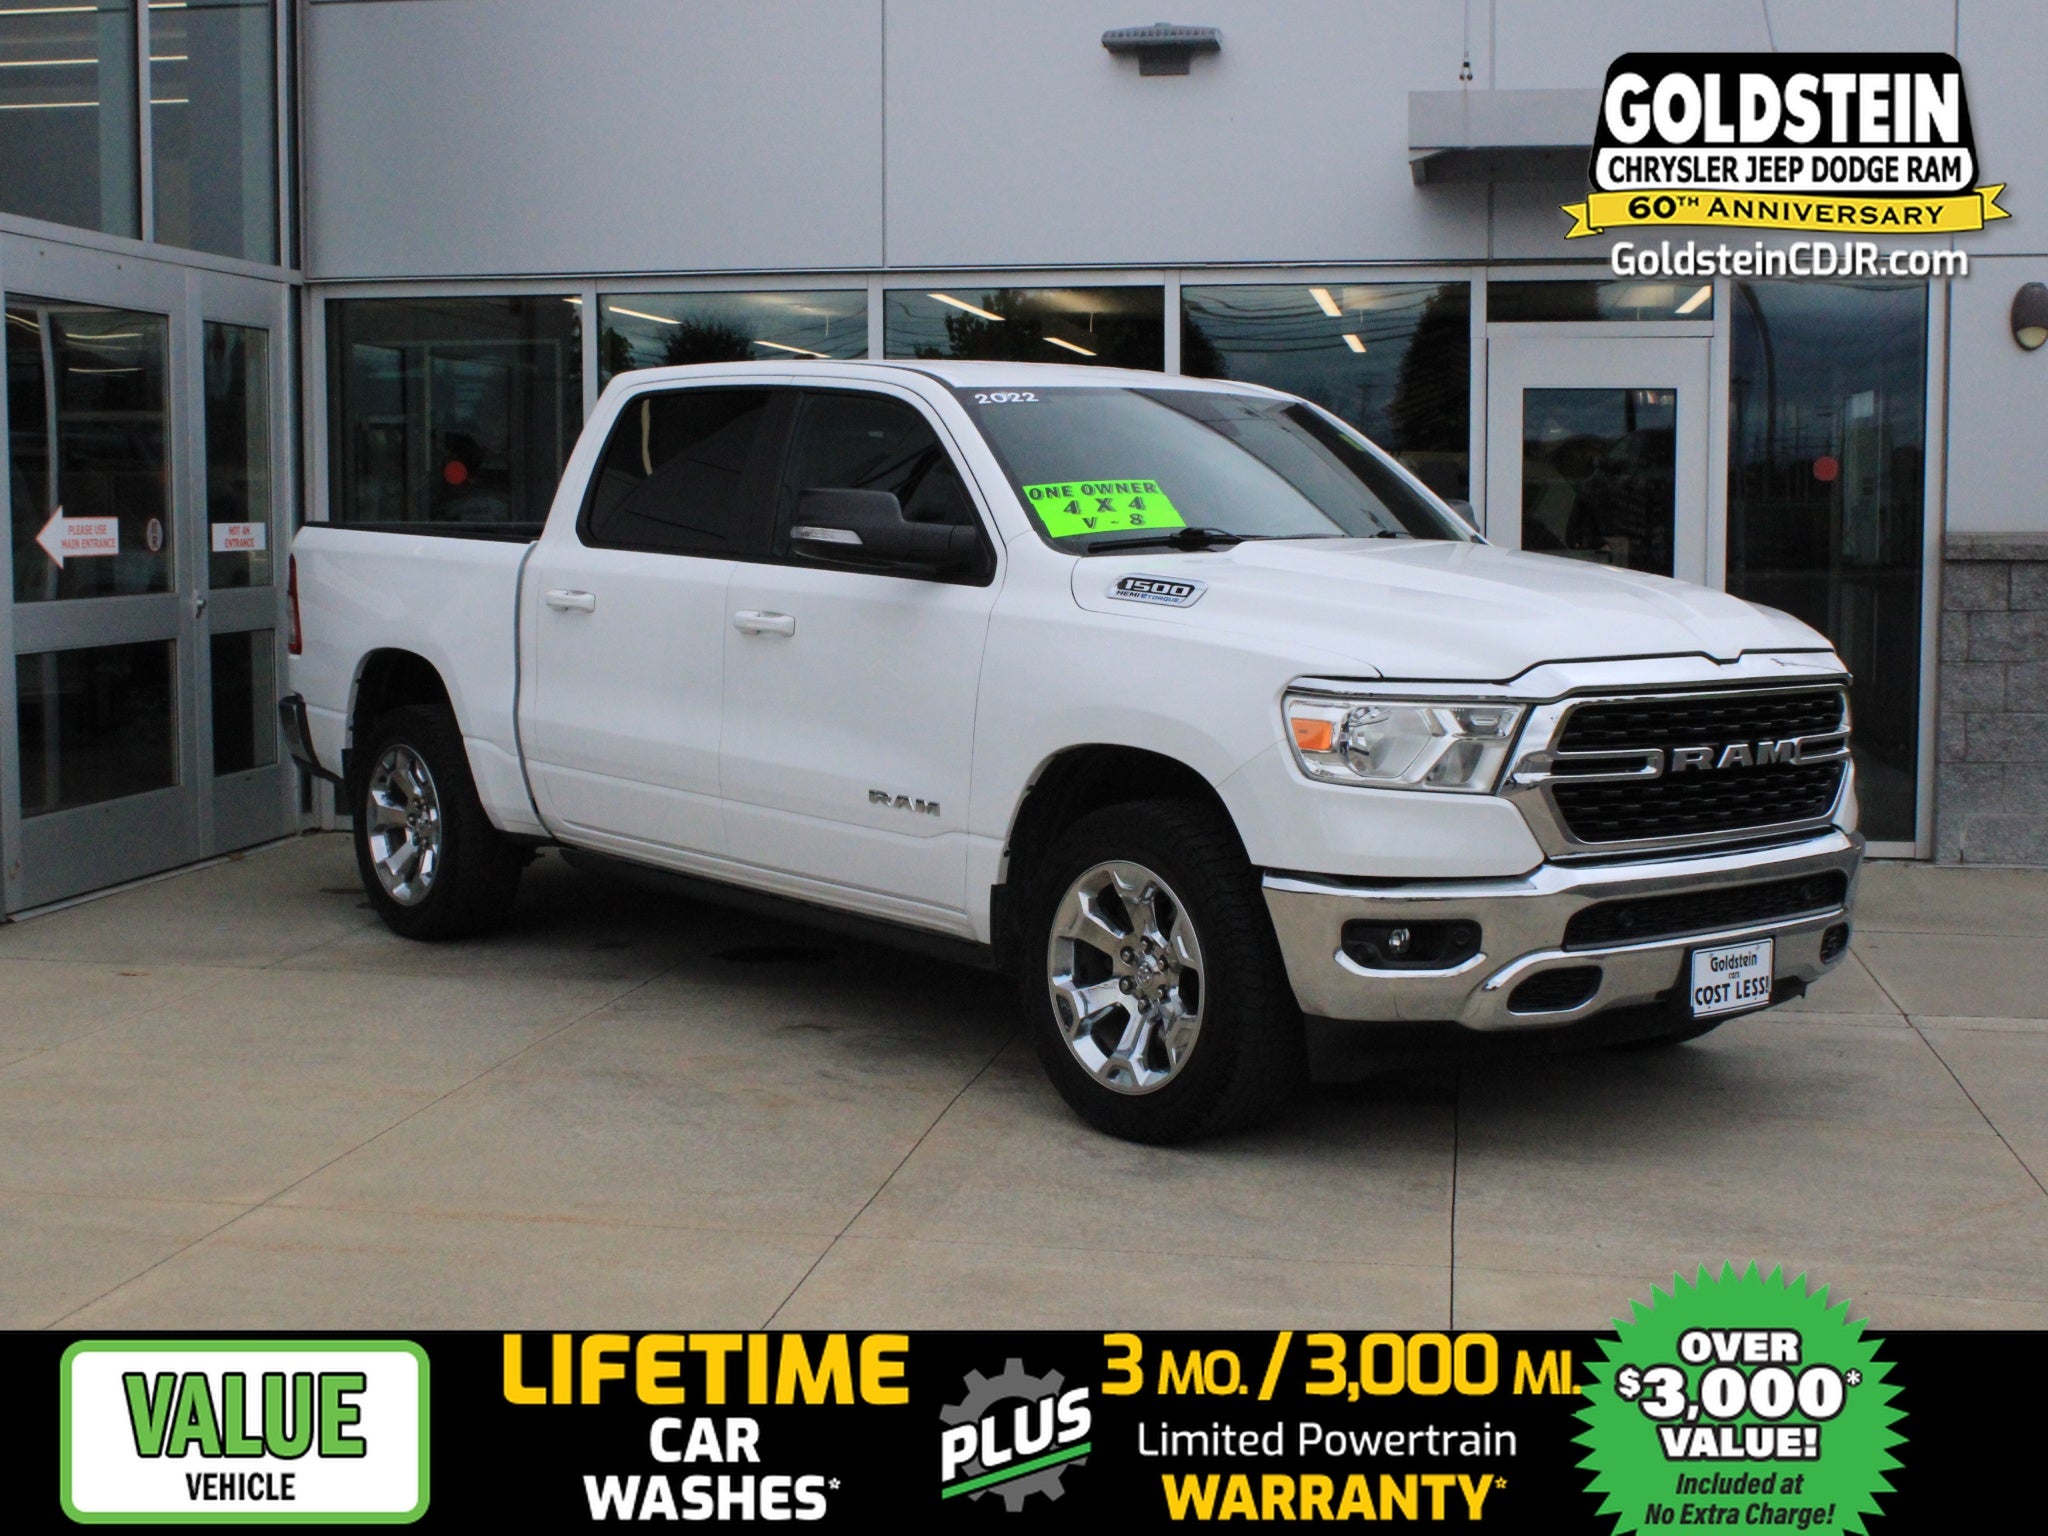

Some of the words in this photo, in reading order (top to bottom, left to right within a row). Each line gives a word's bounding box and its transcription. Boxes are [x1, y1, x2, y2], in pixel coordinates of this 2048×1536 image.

[974, 391, 1040, 405] 2022
[1028, 485, 1074, 500] ONE
[1081, 482, 1160, 496] OWNER
[1063, 500, 1080, 515] 4
[1128, 496, 1146, 511] 4
[1129, 513, 1146, 526] 8
[68, 524, 93, 535] PLEASE
[95, 524, 107, 535] USE
[228, 525, 240, 535] NOT
[242, 525, 251, 535] AN
[61, 538, 80, 549] MAIN
[81, 537, 116, 549] ENTRANCE
[224, 537, 255, 549] ENTRANCE
[1115, 589, 1140, 599] HEMI
[1125, 578, 1191, 596] 1500
[1671, 740, 1794, 772] RAM
[868, 788, 941, 817] RAM
[1710, 952, 1758, 973] Goldstein
[1694, 983, 1731, 1006] COST
[1736, 975, 1770, 1000] LESS!
